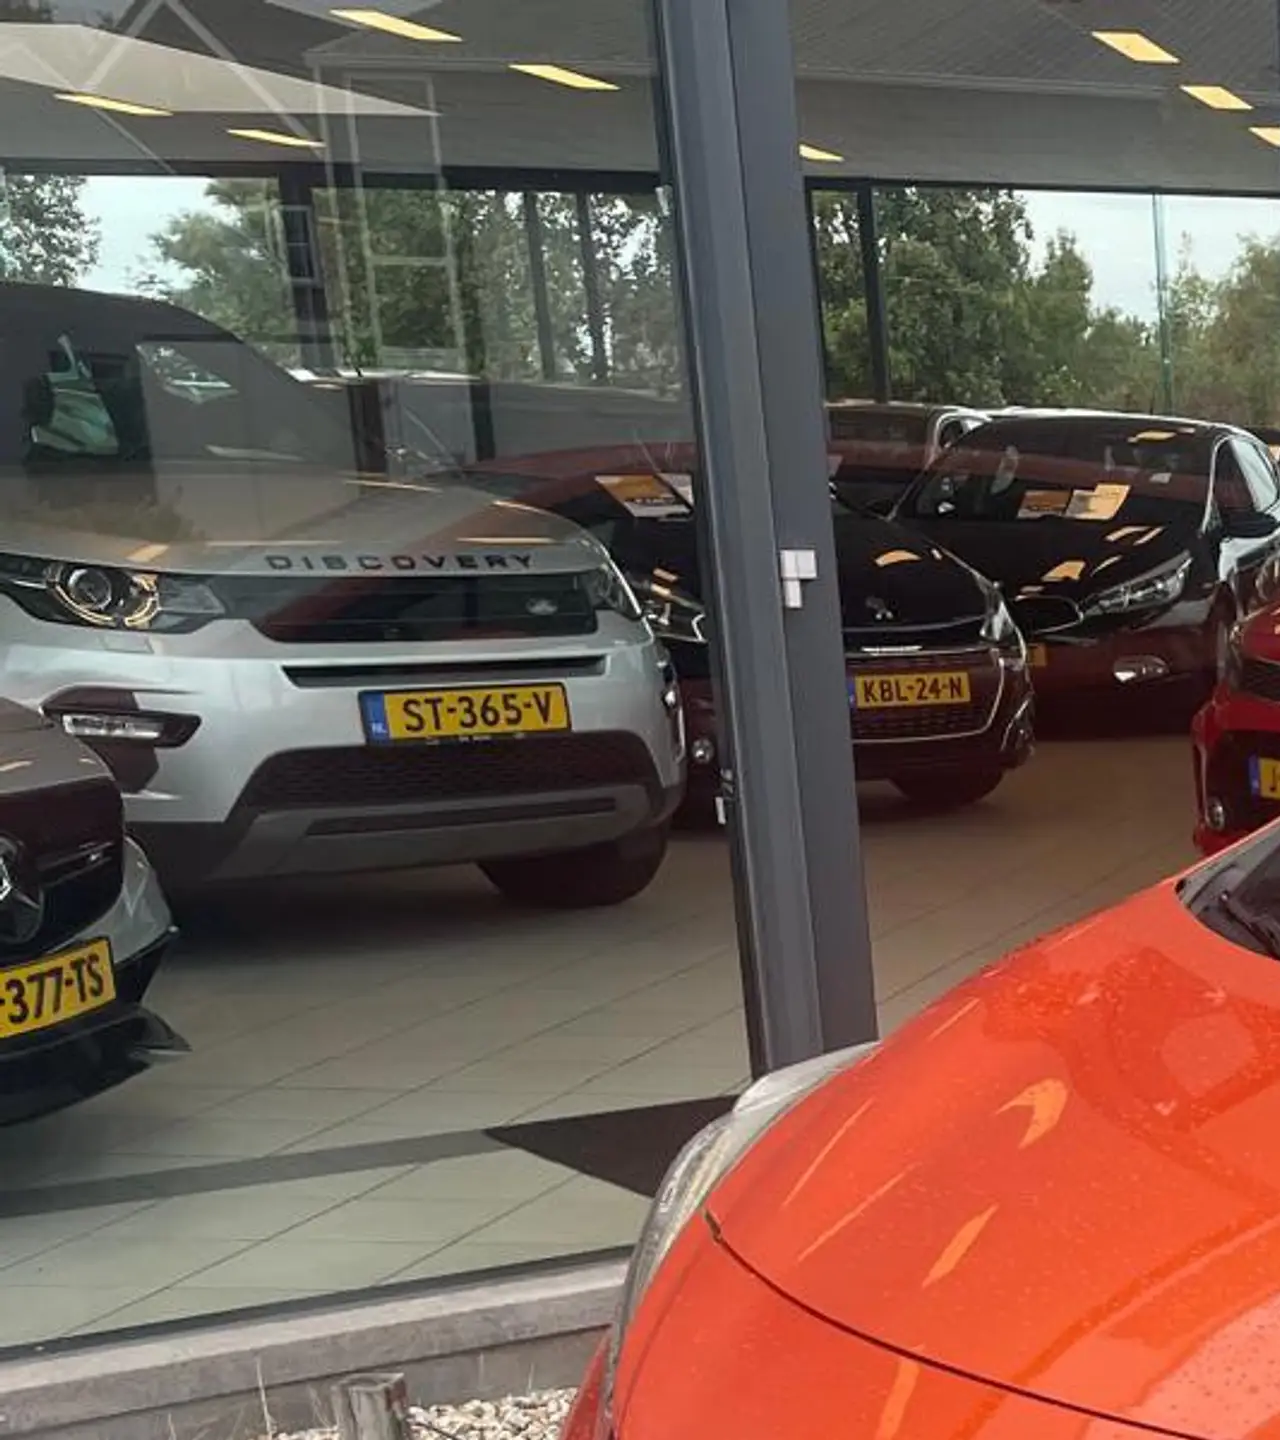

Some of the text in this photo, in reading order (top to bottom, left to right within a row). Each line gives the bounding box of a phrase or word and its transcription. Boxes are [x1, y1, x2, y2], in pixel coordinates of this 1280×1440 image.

[265, 553, 532, 571] DISCOVERY
[862, 676, 963, 703] KBL-24-N
[402, 690, 551, 732] ST-365-V
